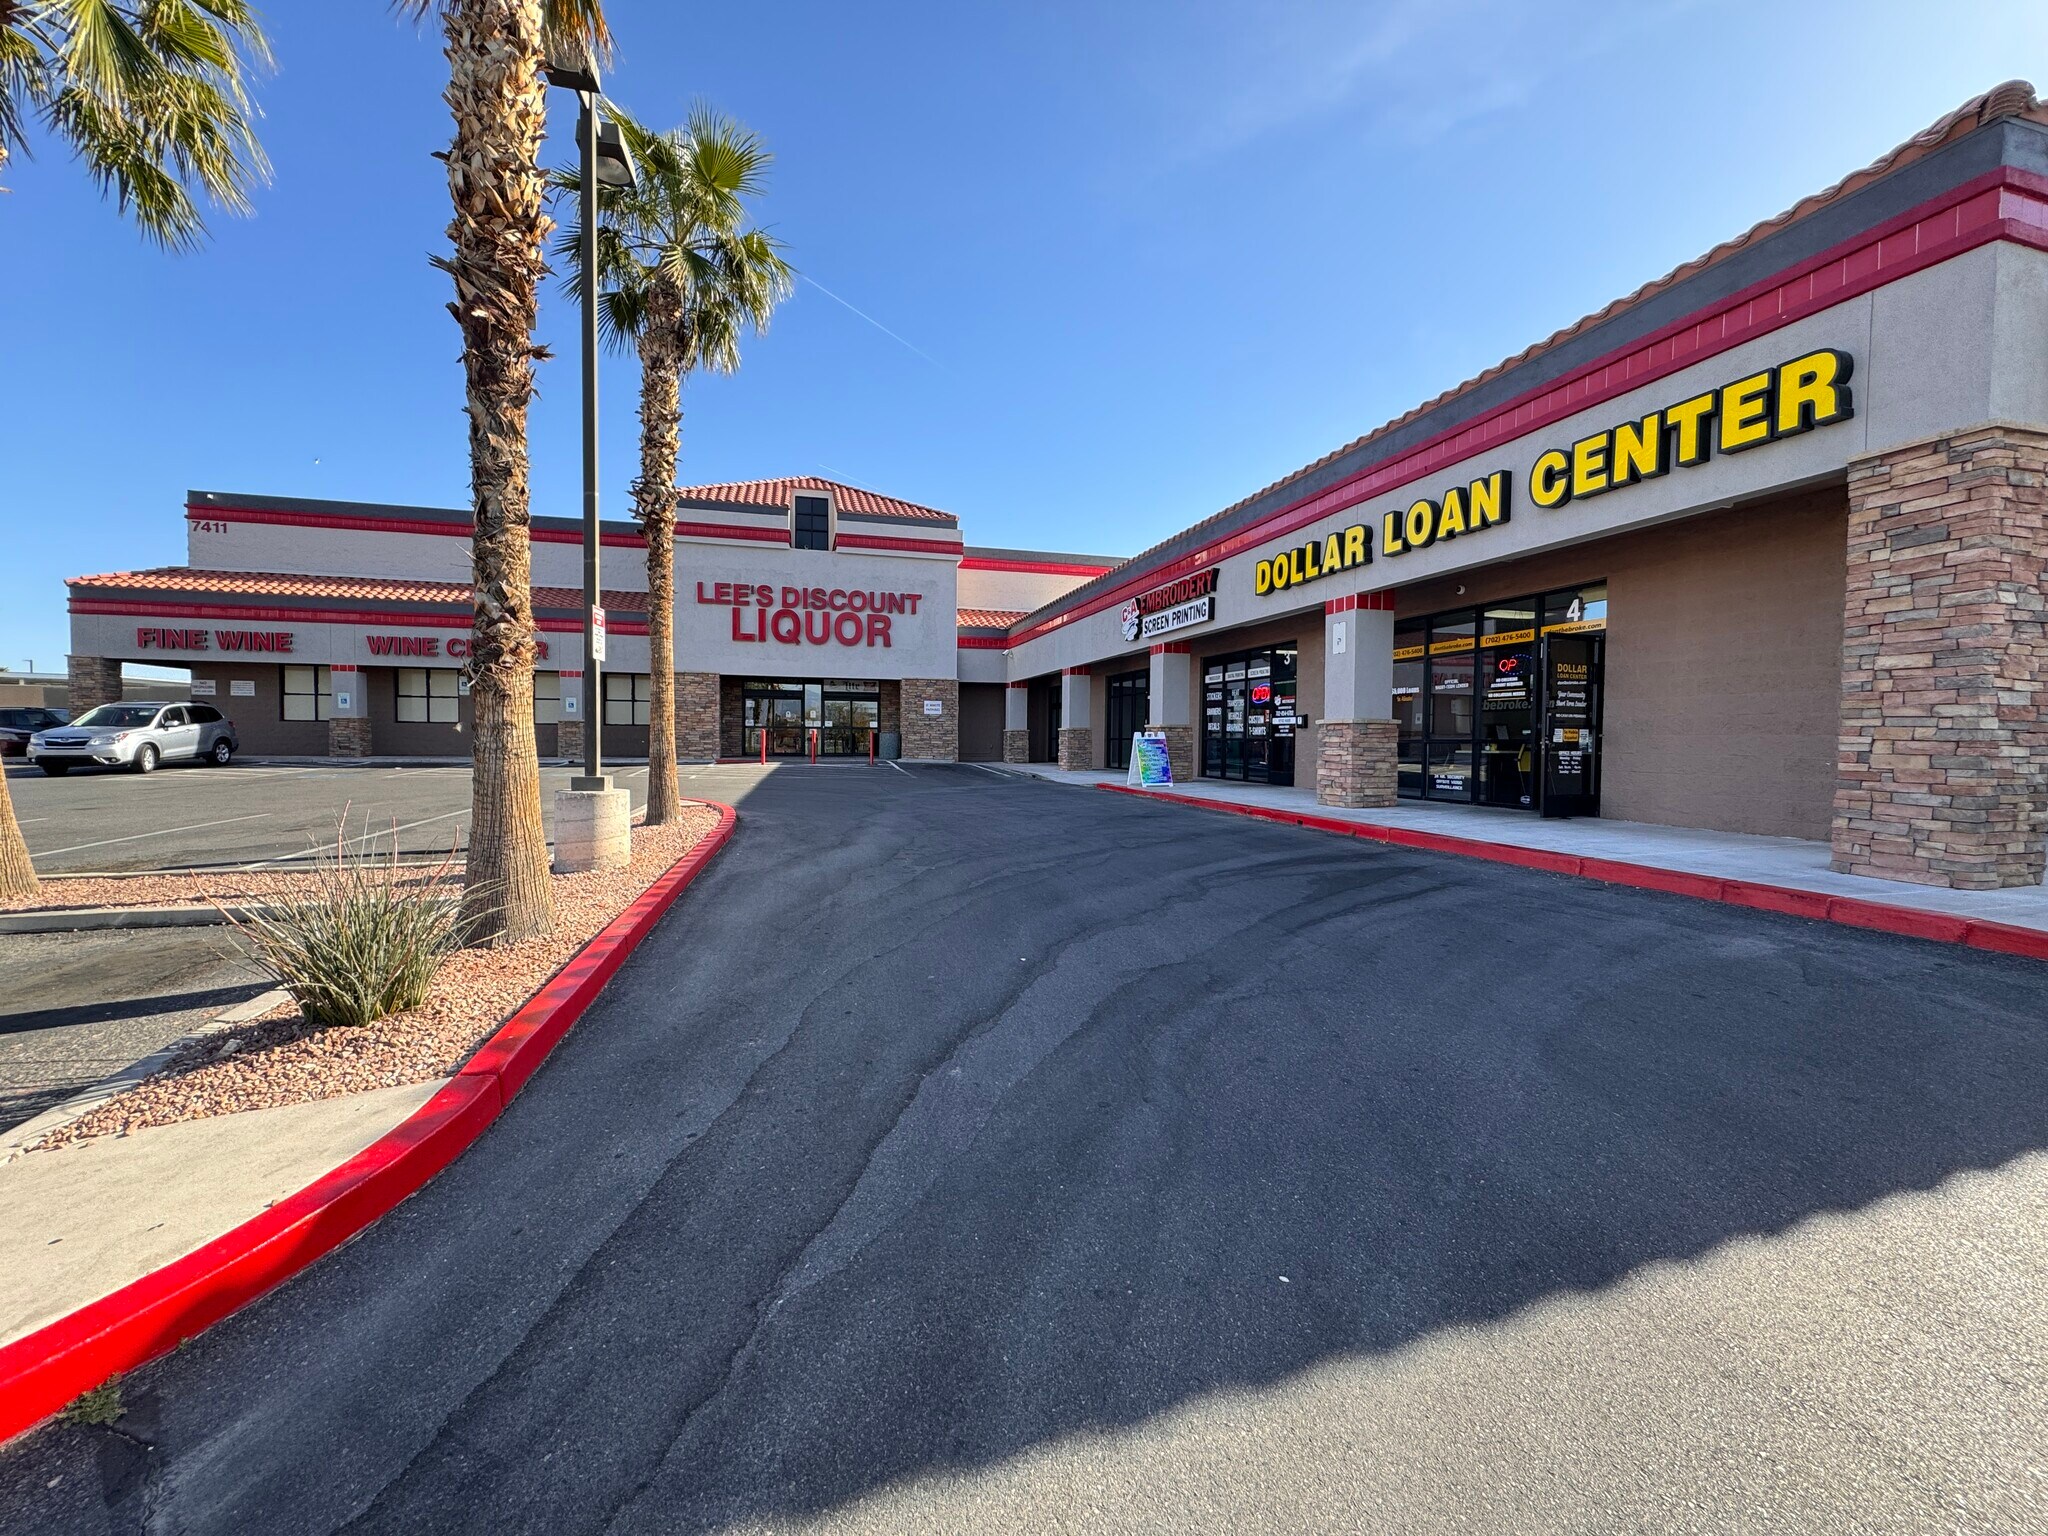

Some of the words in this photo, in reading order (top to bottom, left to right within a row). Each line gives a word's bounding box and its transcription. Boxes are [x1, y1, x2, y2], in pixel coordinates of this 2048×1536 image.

[1255, 524, 1373, 596] DOLLAR
[1382, 469, 1513, 557] LOAN
[1529, 348, 1855, 509] CENTER
[191, 520, 228, 534] 7411
[697, 581, 774, 608] LEE'S
[781, 586, 923, 615] DISCOUNT
[1140, 568, 1217, 615] EMBROIDERY
[1144, 613, 1170, 635] SCREEN
[1171, 601, 1207, 627] PRINTING
[1566, 598, 1581, 622] 4
[137, 627, 208, 650] FINE
[215, 630, 294, 653] WINE
[732, 607, 892, 648] LIQUOR
[1485, 635, 1501, 645] (702)
[1501, 631, 1531, 642] 476-5400
[366, 635, 439, 658] WINE
[1557, 663, 1588, 674] DOLLAR
